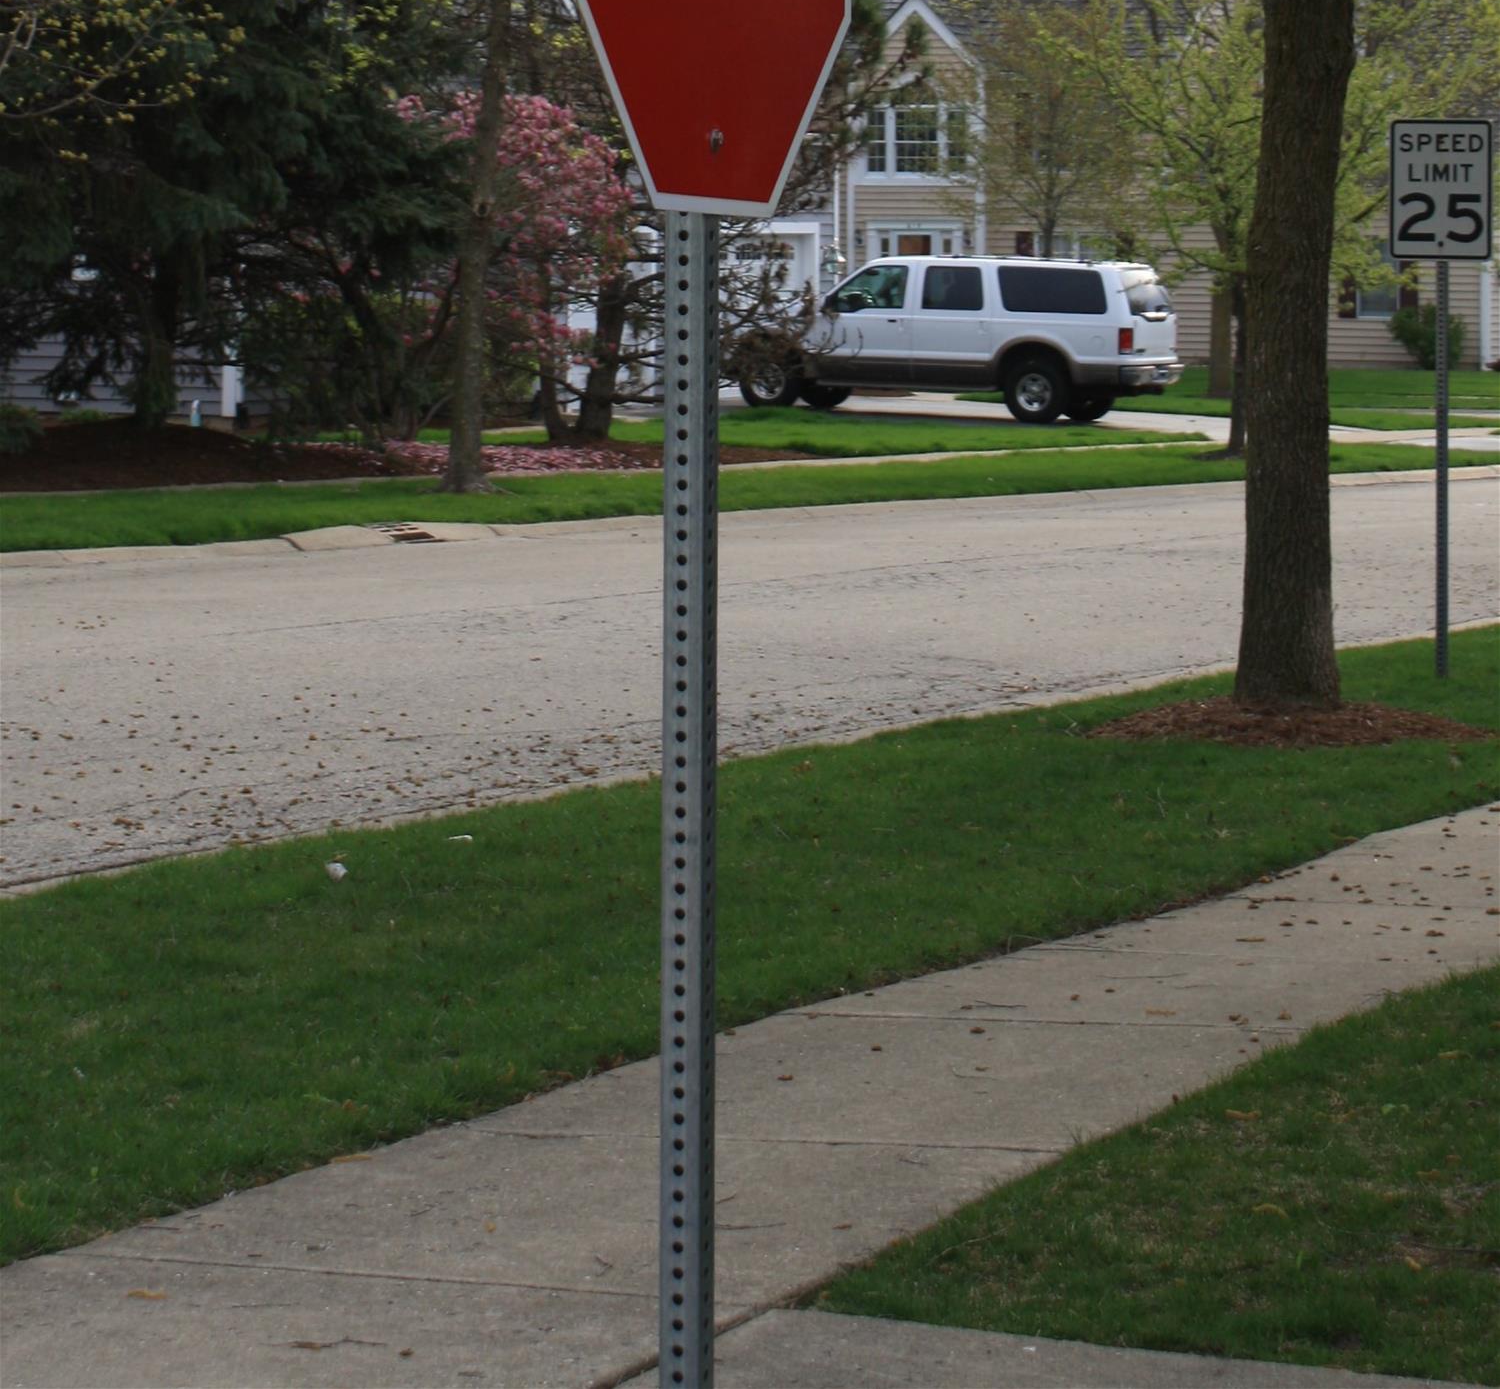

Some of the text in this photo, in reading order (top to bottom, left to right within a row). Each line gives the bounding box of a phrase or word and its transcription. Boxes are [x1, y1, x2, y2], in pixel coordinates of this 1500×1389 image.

[1400, 133, 1483, 152] SPEED
[1408, 163, 1473, 182] LIMIT
[1398, 192, 1483, 243] 25
